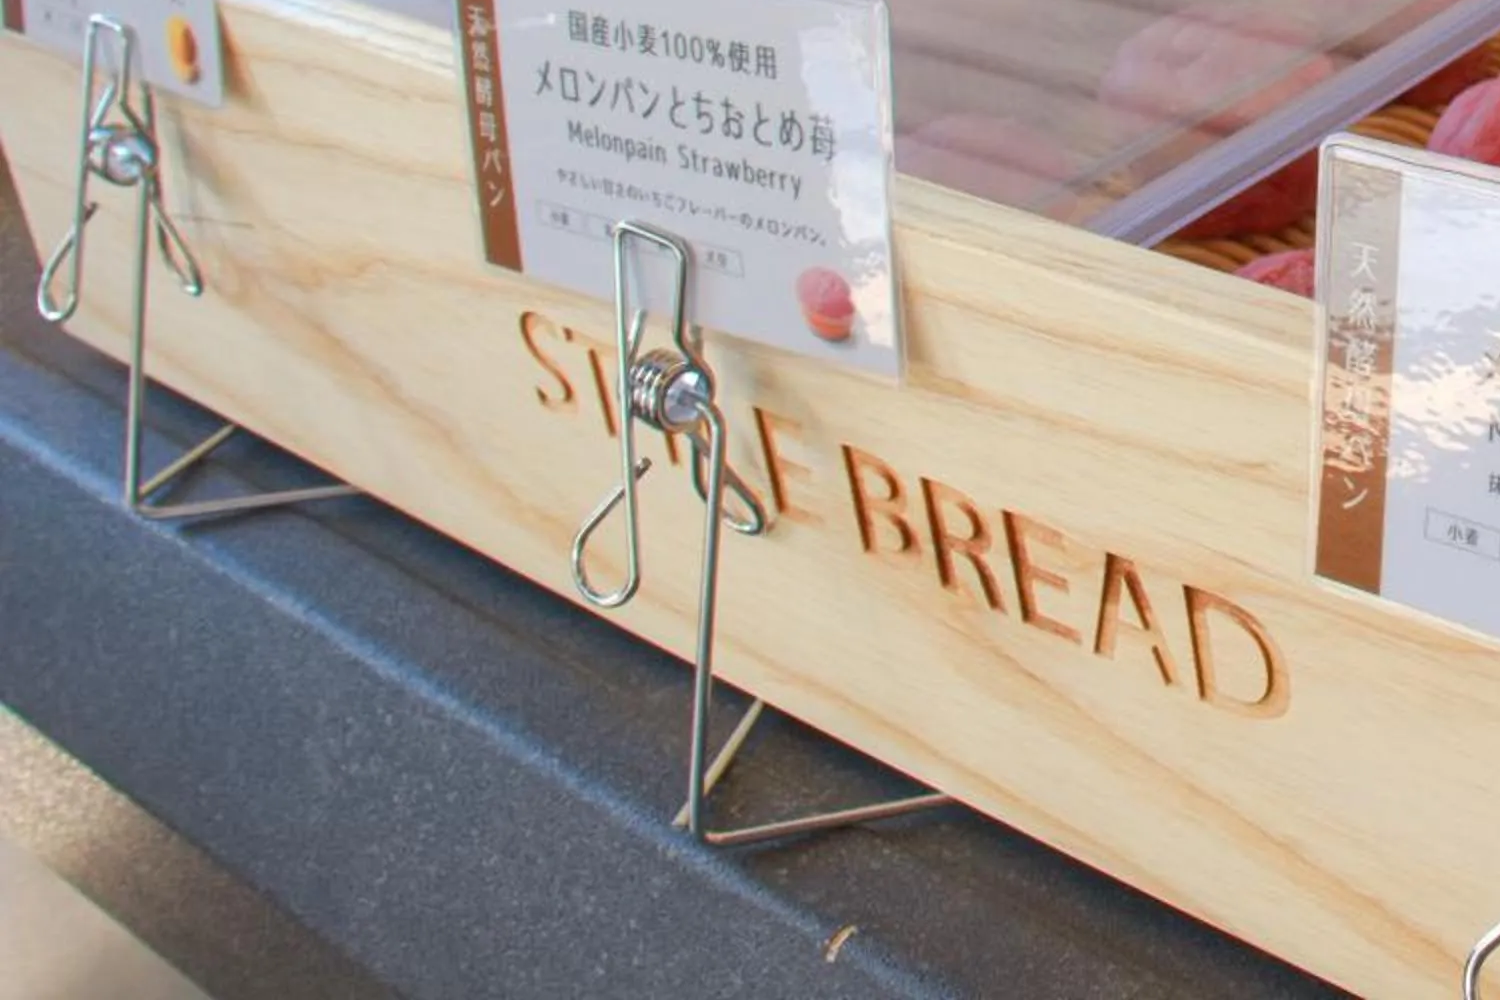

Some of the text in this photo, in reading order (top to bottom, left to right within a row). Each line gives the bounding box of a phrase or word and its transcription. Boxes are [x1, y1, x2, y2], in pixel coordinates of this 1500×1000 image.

[568, 9, 778, 80] 国産小麦100%使用
[535, 59, 837, 162] メロンパンとちおとめ苺
[567, 120, 803, 201] Melonpain Strawberry
[518, 310, 1292, 719] STE BREAD
